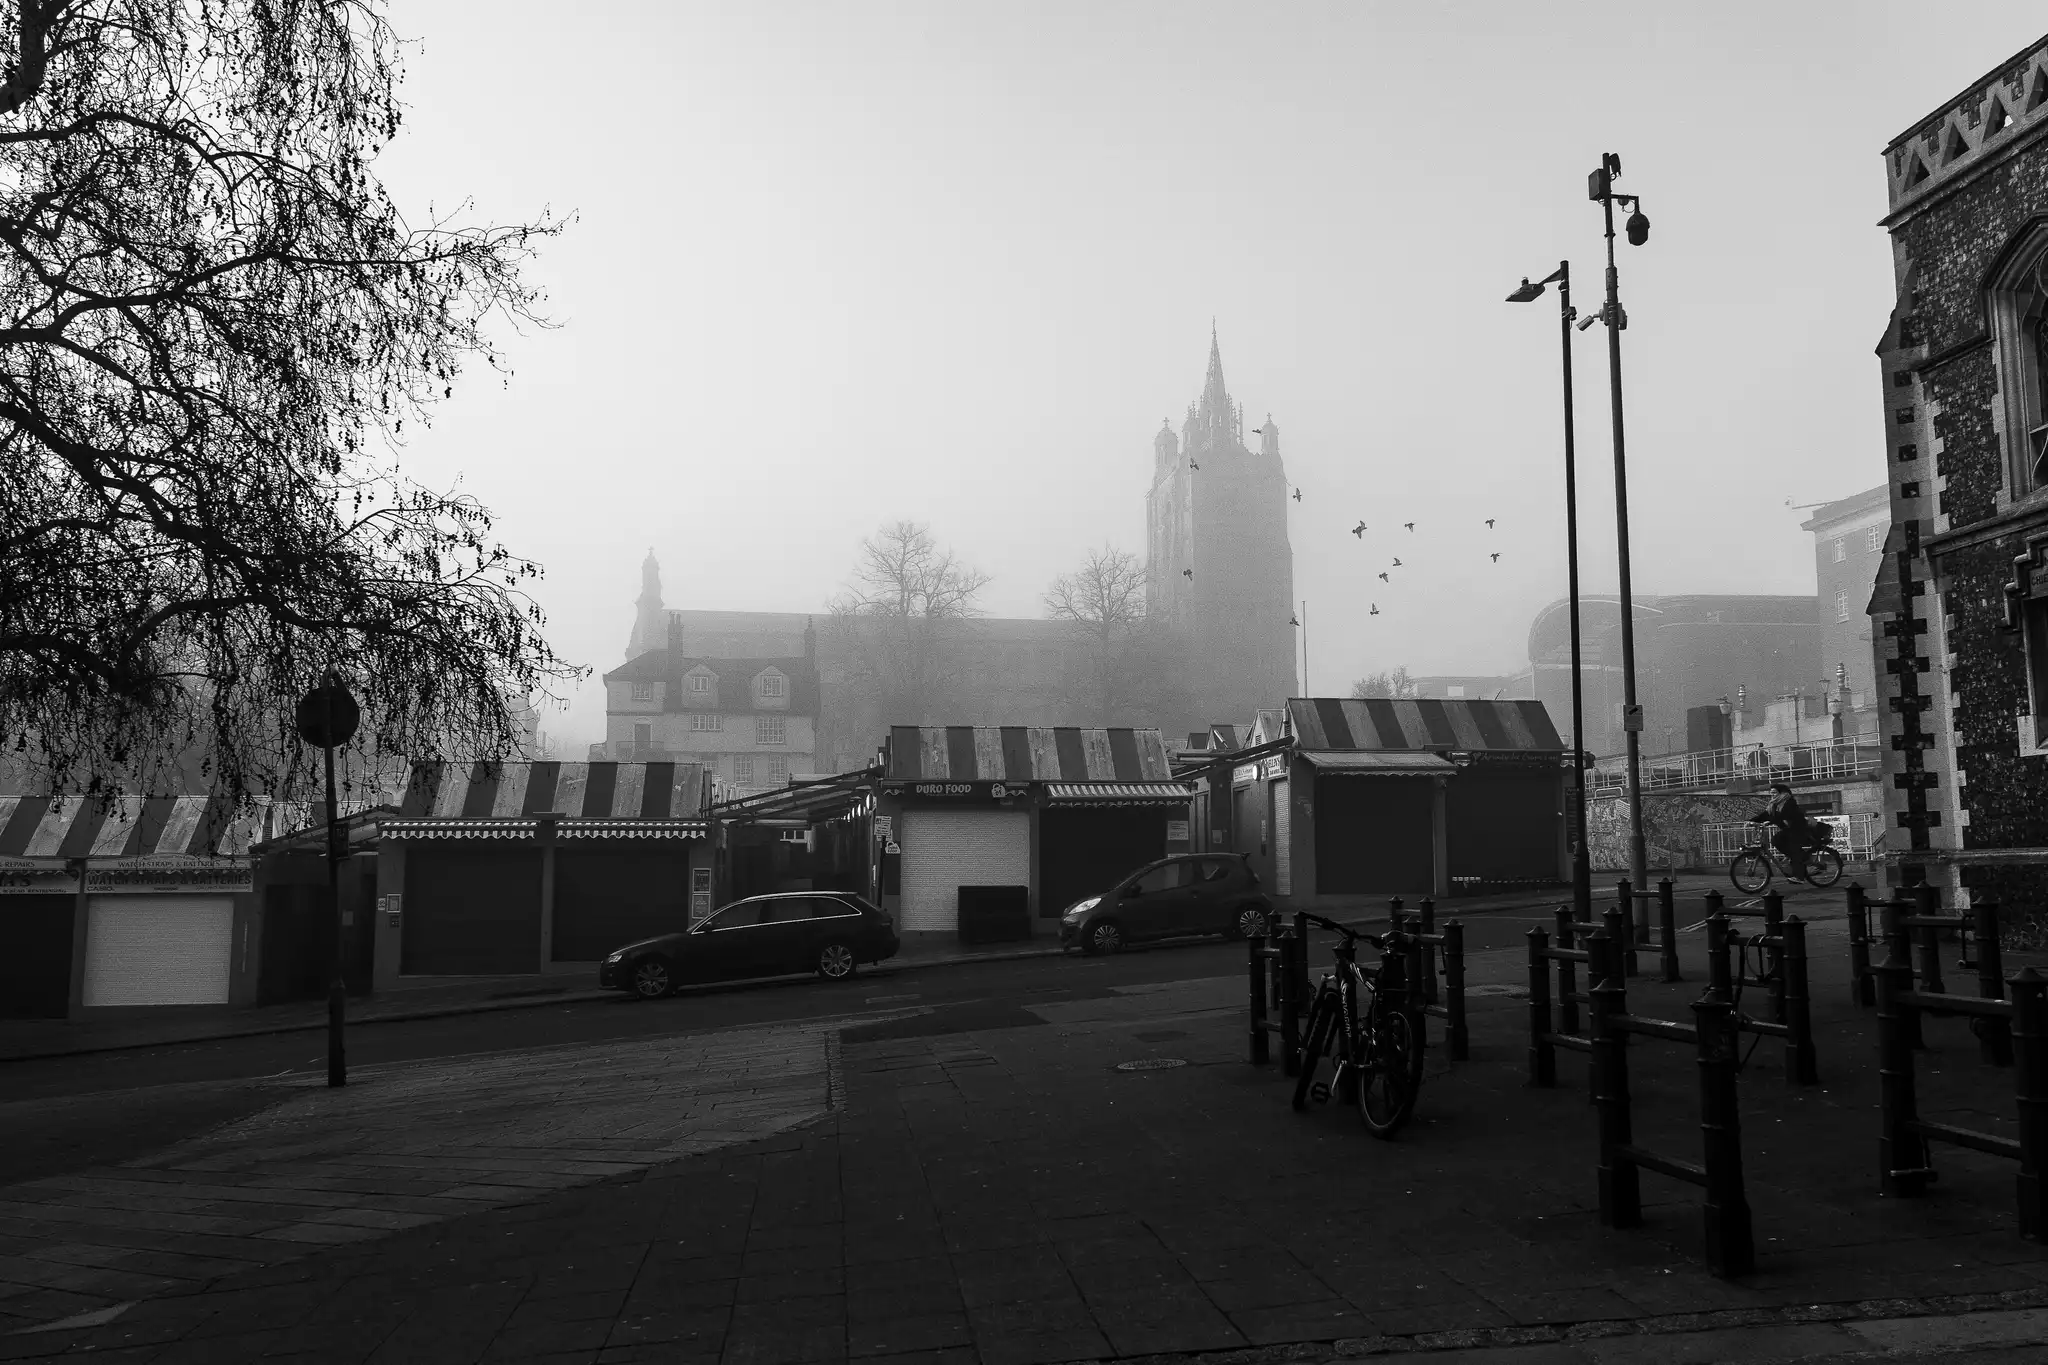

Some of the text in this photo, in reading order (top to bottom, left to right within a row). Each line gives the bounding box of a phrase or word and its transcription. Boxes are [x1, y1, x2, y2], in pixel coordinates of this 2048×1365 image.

[916, 784, 972, 794] DURO FOOD
[88, 874, 128, 885] WATCH
[191, 873, 252, 885] BATTERIES
